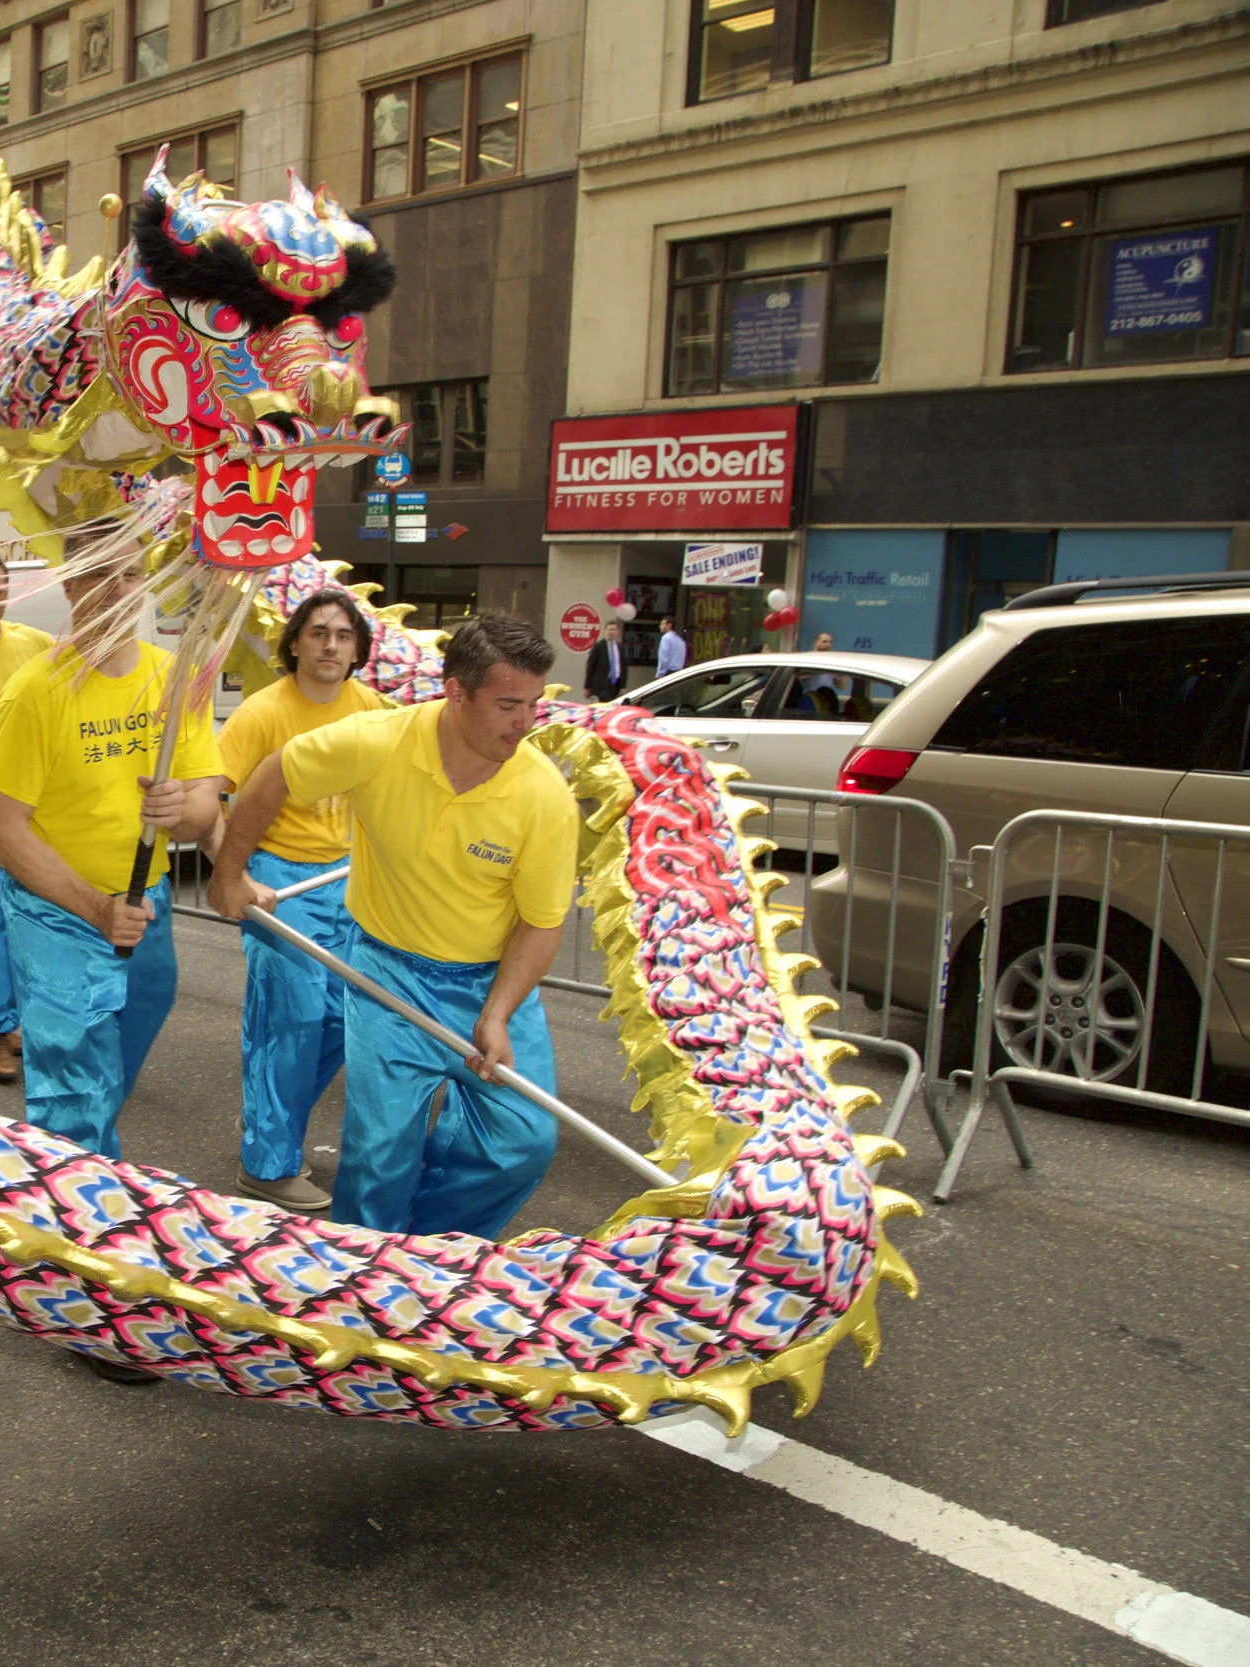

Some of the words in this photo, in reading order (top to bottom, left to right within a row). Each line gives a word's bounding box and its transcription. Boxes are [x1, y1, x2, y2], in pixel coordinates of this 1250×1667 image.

[557, 448, 652, 482] Lucille
[656, 437, 786, 479] Roberts
[554, 491, 637, 508] FITNESS
[647, 491, 688, 506] FOR
[699, 489, 784, 505] WOMEN
[685, 559, 711, 578] SALE
[712, 546, 759, 570] ENDING!
[810, 571, 842, 587] High
[846, 571, 886, 586] Traffic
[890, 571, 929, 587] Retail
[80, 718, 121, 739] FALUN
[466, 843, 494, 861] FALUN
